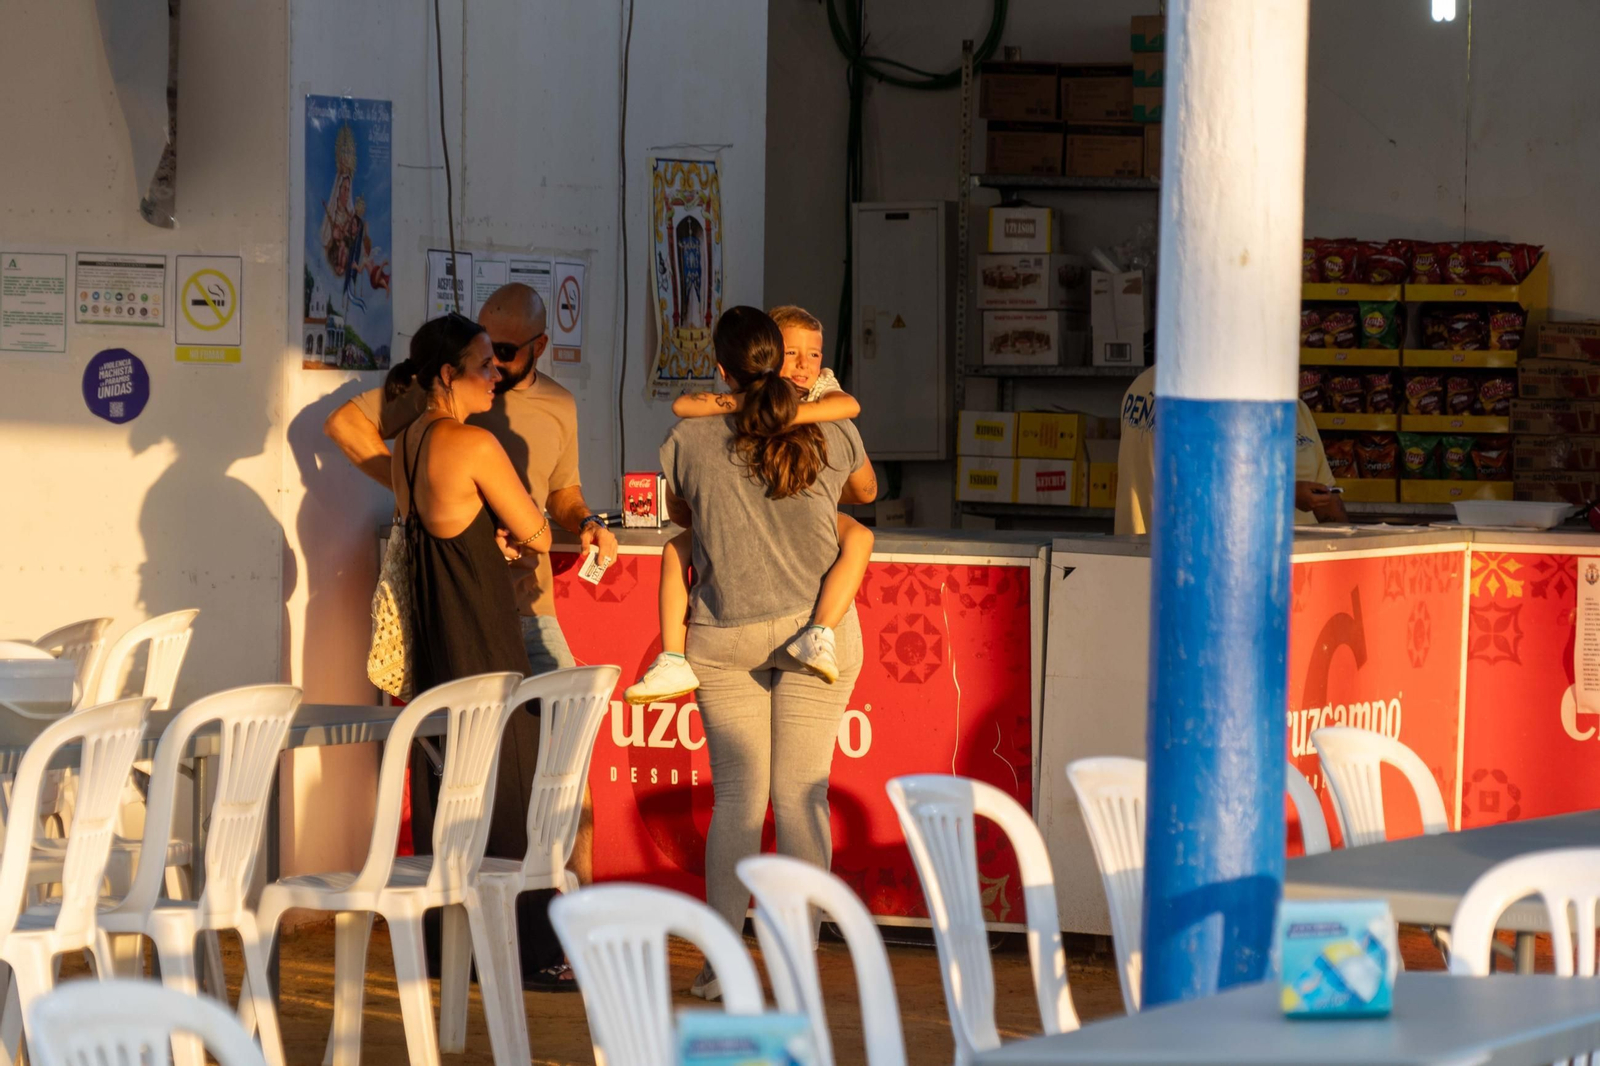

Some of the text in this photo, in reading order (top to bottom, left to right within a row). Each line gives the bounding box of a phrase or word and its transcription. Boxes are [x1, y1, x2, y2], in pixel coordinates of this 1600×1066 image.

[1005, 223, 1035, 234] MOSTAZA
[437, 277, 464, 291] ACEPTAOS
[103, 358, 132, 370] VIOLENCIA
[98, 365, 133, 380] MACHISTA
[104, 375, 131, 386] PARAMOS
[1406, 376, 1439, 395] Ruffles
[97, 382, 133, 399] UNIDAS
[1328, 459, 1348, 467] oritos
[1363, 462, 1391, 471] Doritos
[628, 478, 652, 489] Coca-Cola
[1036, 475, 1066, 487] KETCHUP
[610, 765, 699, 787] DESDE
